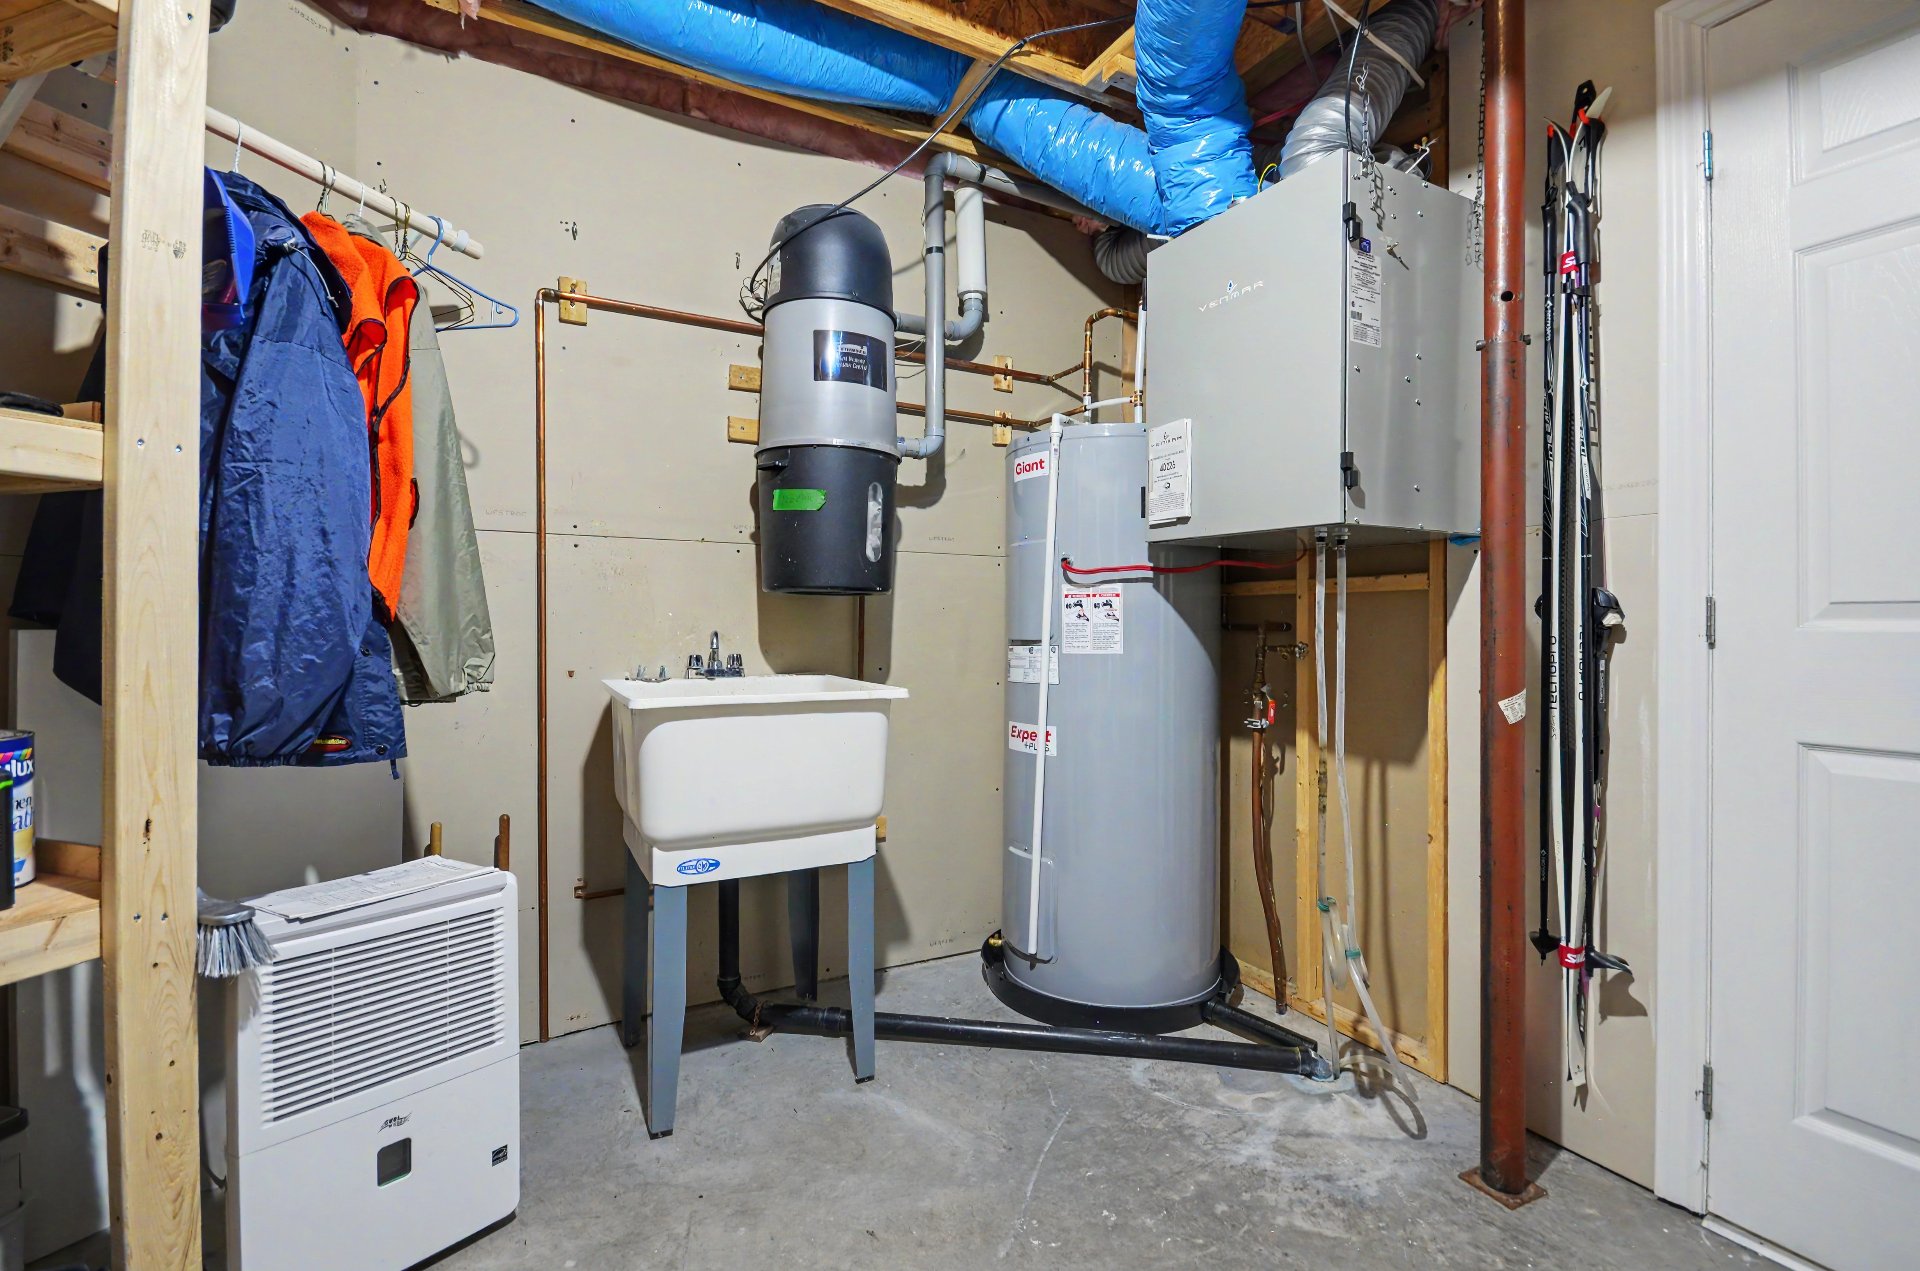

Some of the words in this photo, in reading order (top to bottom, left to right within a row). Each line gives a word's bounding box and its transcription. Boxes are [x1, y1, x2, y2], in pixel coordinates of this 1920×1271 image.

[1199, 280, 1264, 312] VENMAR
[1016, 459, 1045, 475] Giant
[1010, 725, 1051, 743] Expet
[1024, 741, 1050, 752] +PLS
